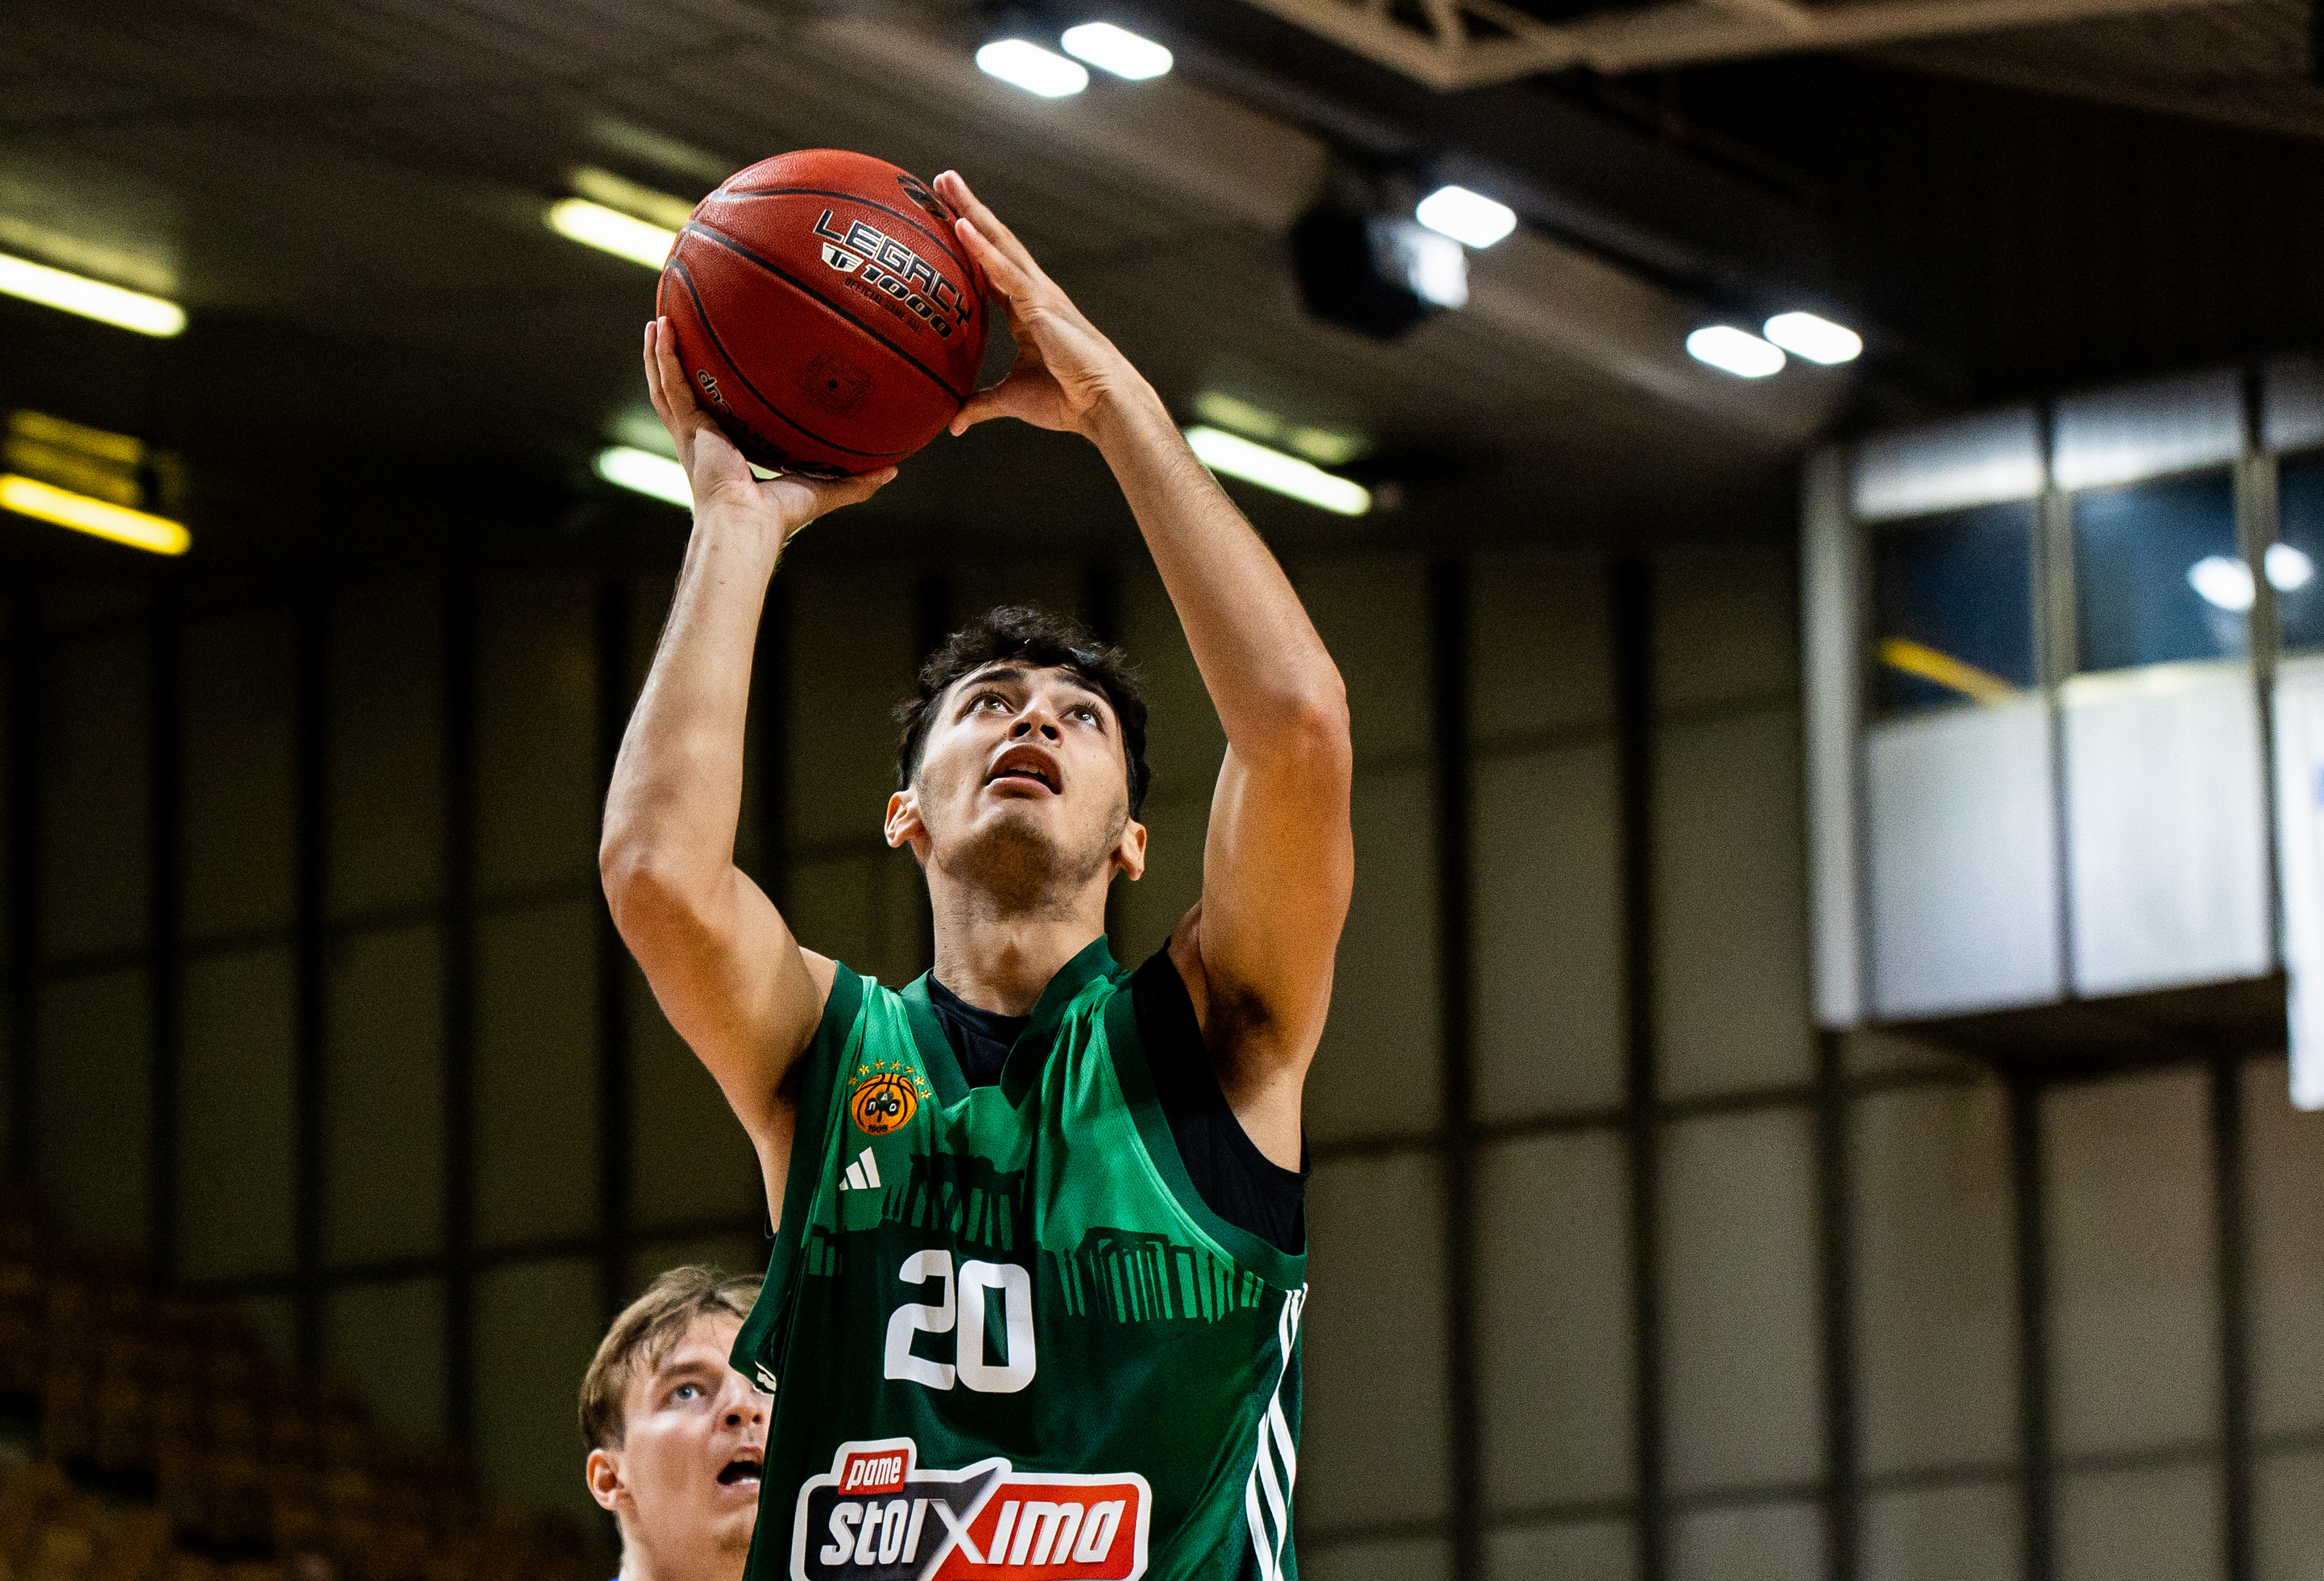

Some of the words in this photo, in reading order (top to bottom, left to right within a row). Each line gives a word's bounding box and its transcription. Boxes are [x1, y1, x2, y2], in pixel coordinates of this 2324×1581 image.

[813, 209, 973, 326] LEGACY
[844, 278, 882, 303] OFFICIAL
[860, 264, 952, 339] 1000
[884, 1249, 1036, 1393] 20
[845, 1456, 902, 1490] pame
